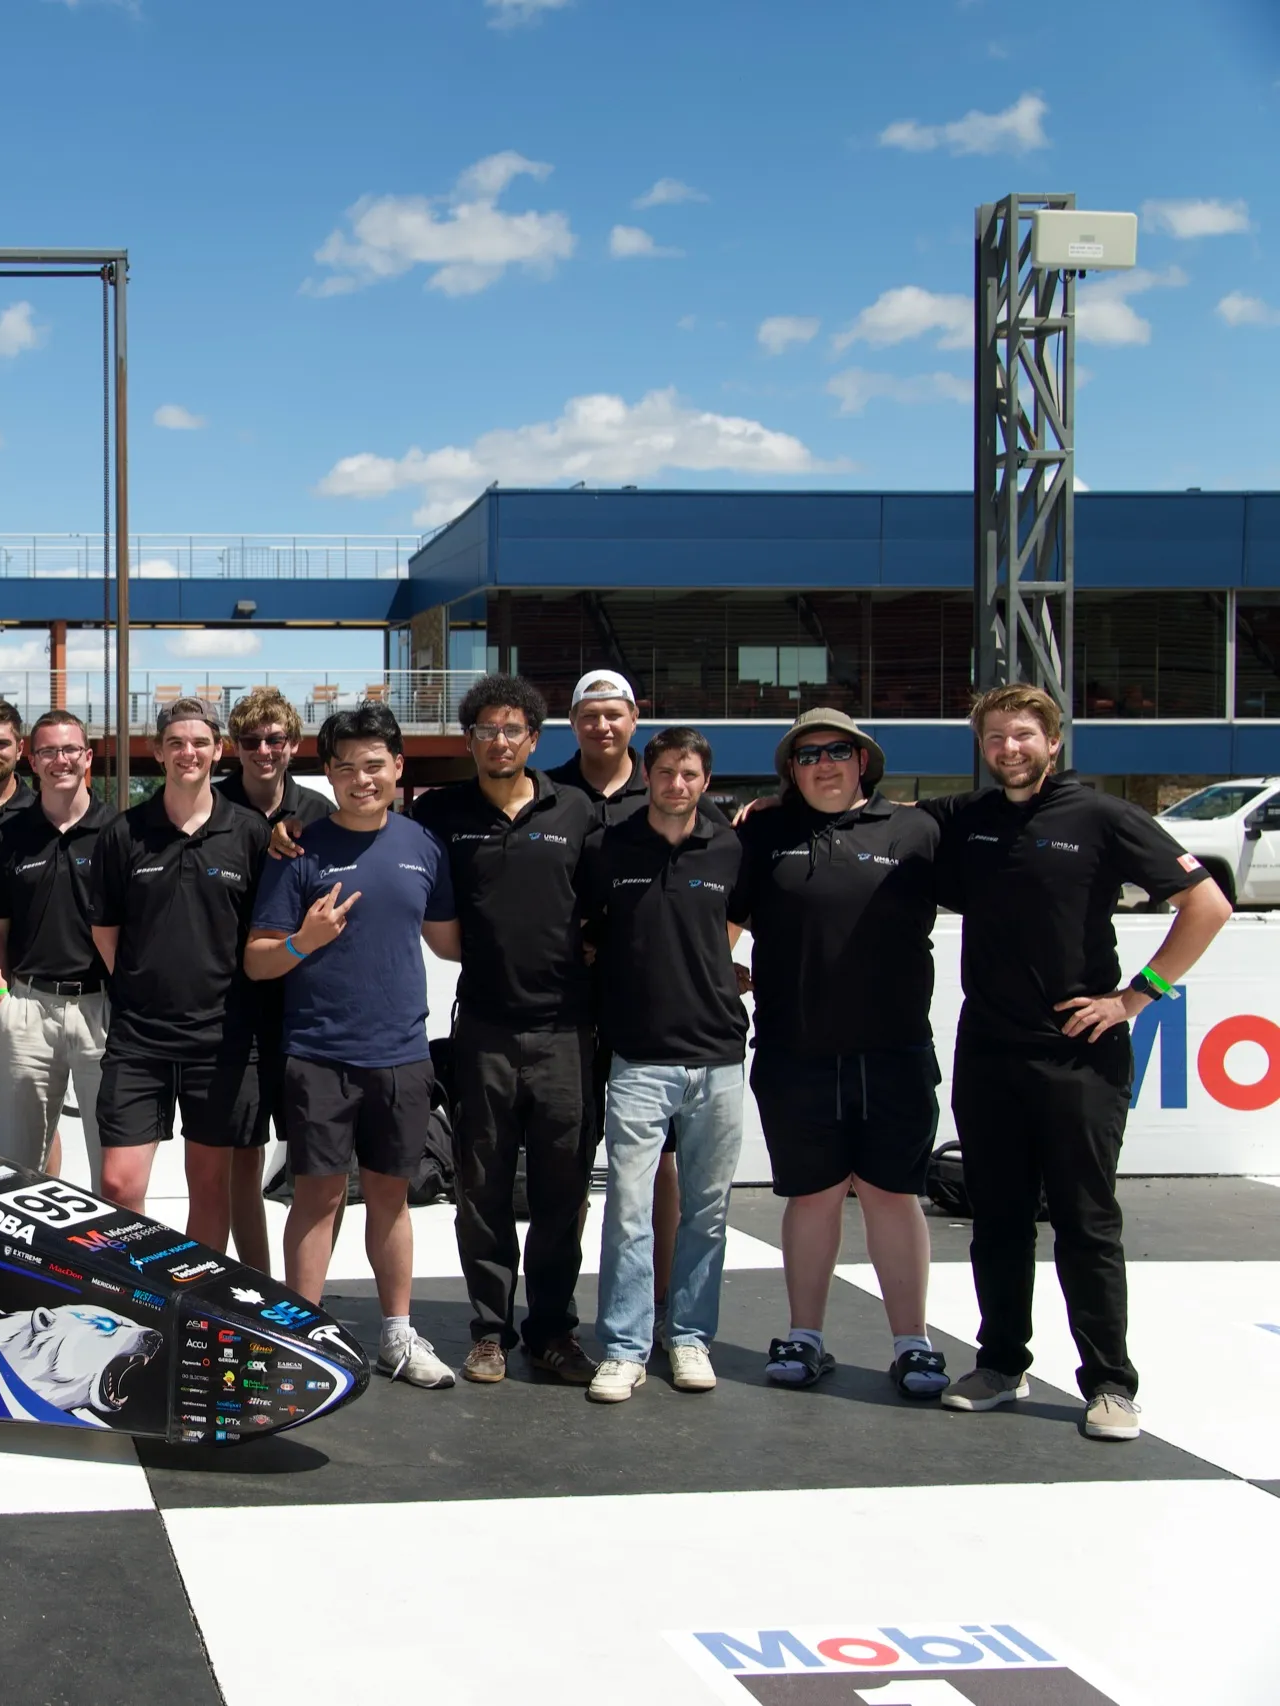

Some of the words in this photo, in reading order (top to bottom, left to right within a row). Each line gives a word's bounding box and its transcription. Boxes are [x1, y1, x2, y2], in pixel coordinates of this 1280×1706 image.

[13, 1186, 98, 1221] 95
[103, 1221, 147, 1238] Midwest
[12, 1249, 43, 1264] EXTREME
[141, 1248, 171, 1264] DYNAMIC
[170, 1240, 200, 1256] MACHINE
[48, 1263, 83, 1280] MacDon
[173, 1260, 219, 1279] Technology
[91, 1277, 121, 1292] MERIDIAN
[132, 1298, 162, 1311] RADIATORS
[260, 1300, 311, 1326] SAE
[246, 1360, 267, 1373] COX
[225, 1417, 241, 1426] PTx
[692, 1624, 1058, 1669] Mobil
